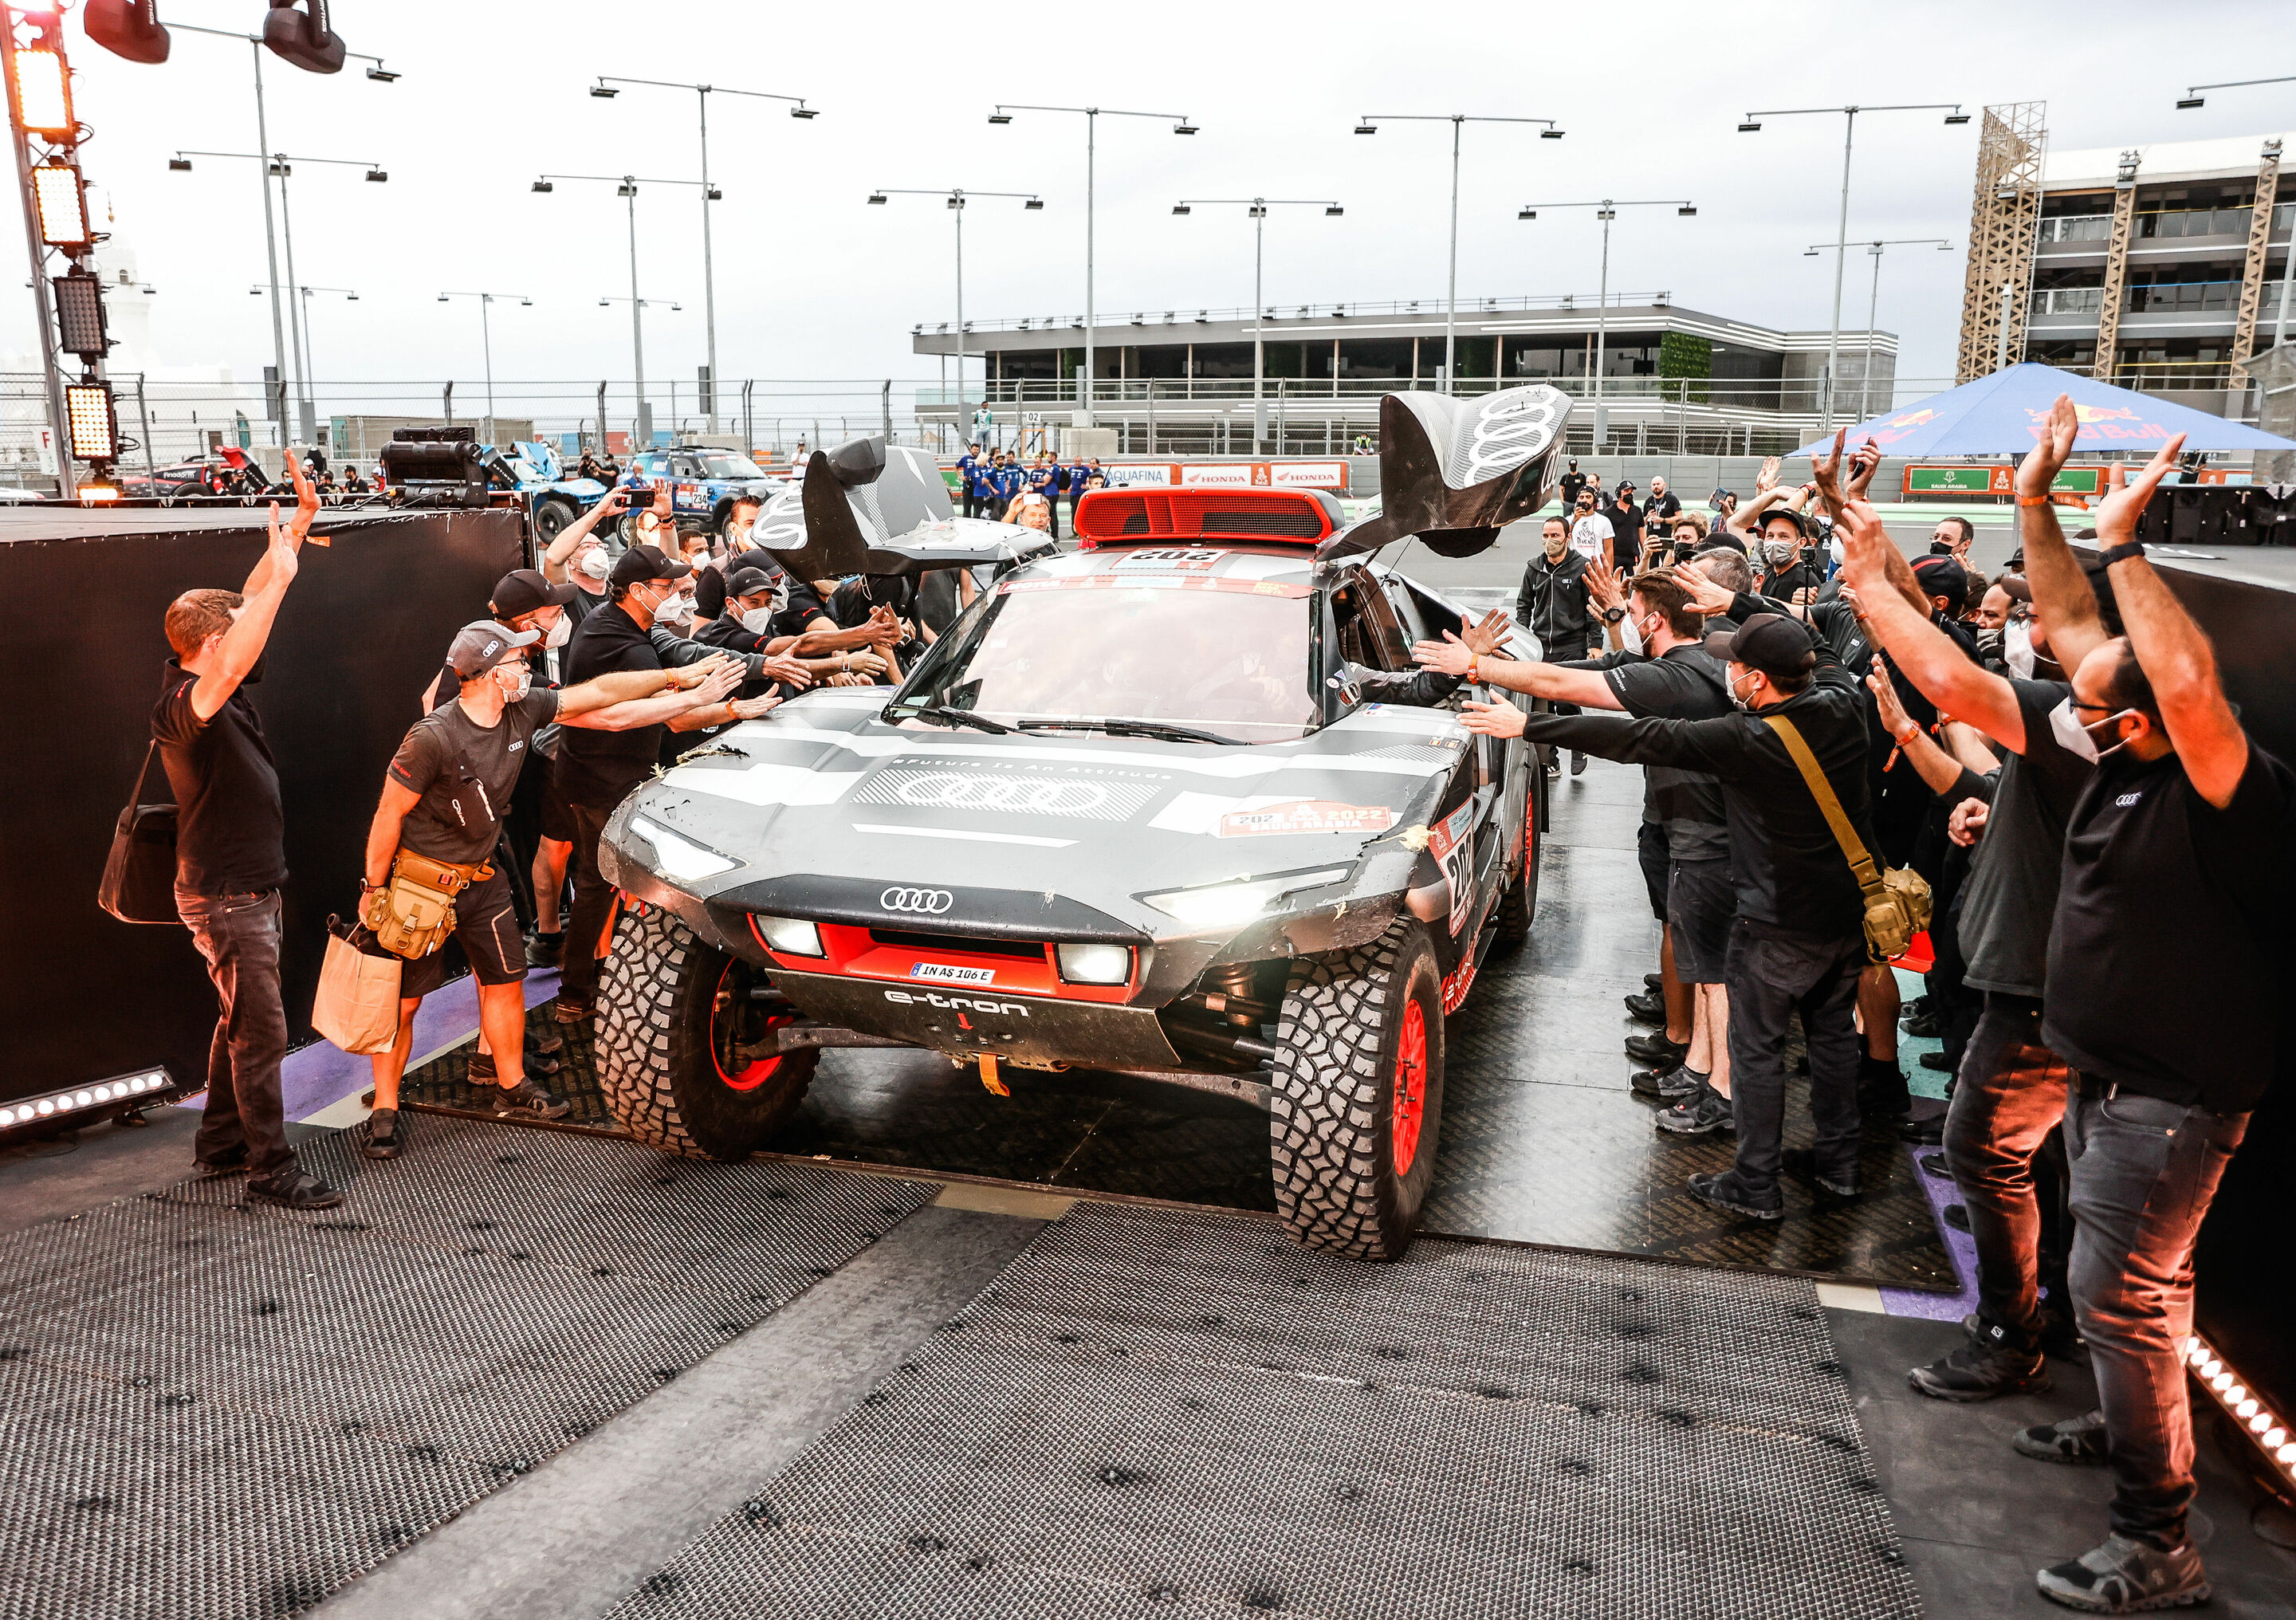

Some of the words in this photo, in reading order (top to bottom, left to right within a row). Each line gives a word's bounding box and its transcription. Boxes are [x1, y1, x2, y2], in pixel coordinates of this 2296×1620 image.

[1028, 412, 1039, 421] 02
[2026, 424, 2101, 440] Rd
[2102, 423, 2170, 439] Bull
[42, 431, 50, 449] F
[1107, 470, 1163, 483] AQUAFINA
[694, 493, 707, 505] 234
[1130, 551, 1218, 560] 202
[1003, 579, 1063, 592] MOTUL
[892, 758, 981, 768] #Future
[1065, 767, 1173, 781] Attitude
[1239, 815, 1274, 824] 202
[1326, 810, 1383, 820] 2022
[1249, 820, 1297, 832] SAUDI
[1302, 820, 1362, 830] ARABIA
[1447, 832, 1472, 911] 202
[922, 965, 937, 977] IN
[939, 968, 953, 978] AS
[956, 969, 978, 980] 106
[981, 971, 990, 981] E
[883, 989, 1030, 1018] e-tron
